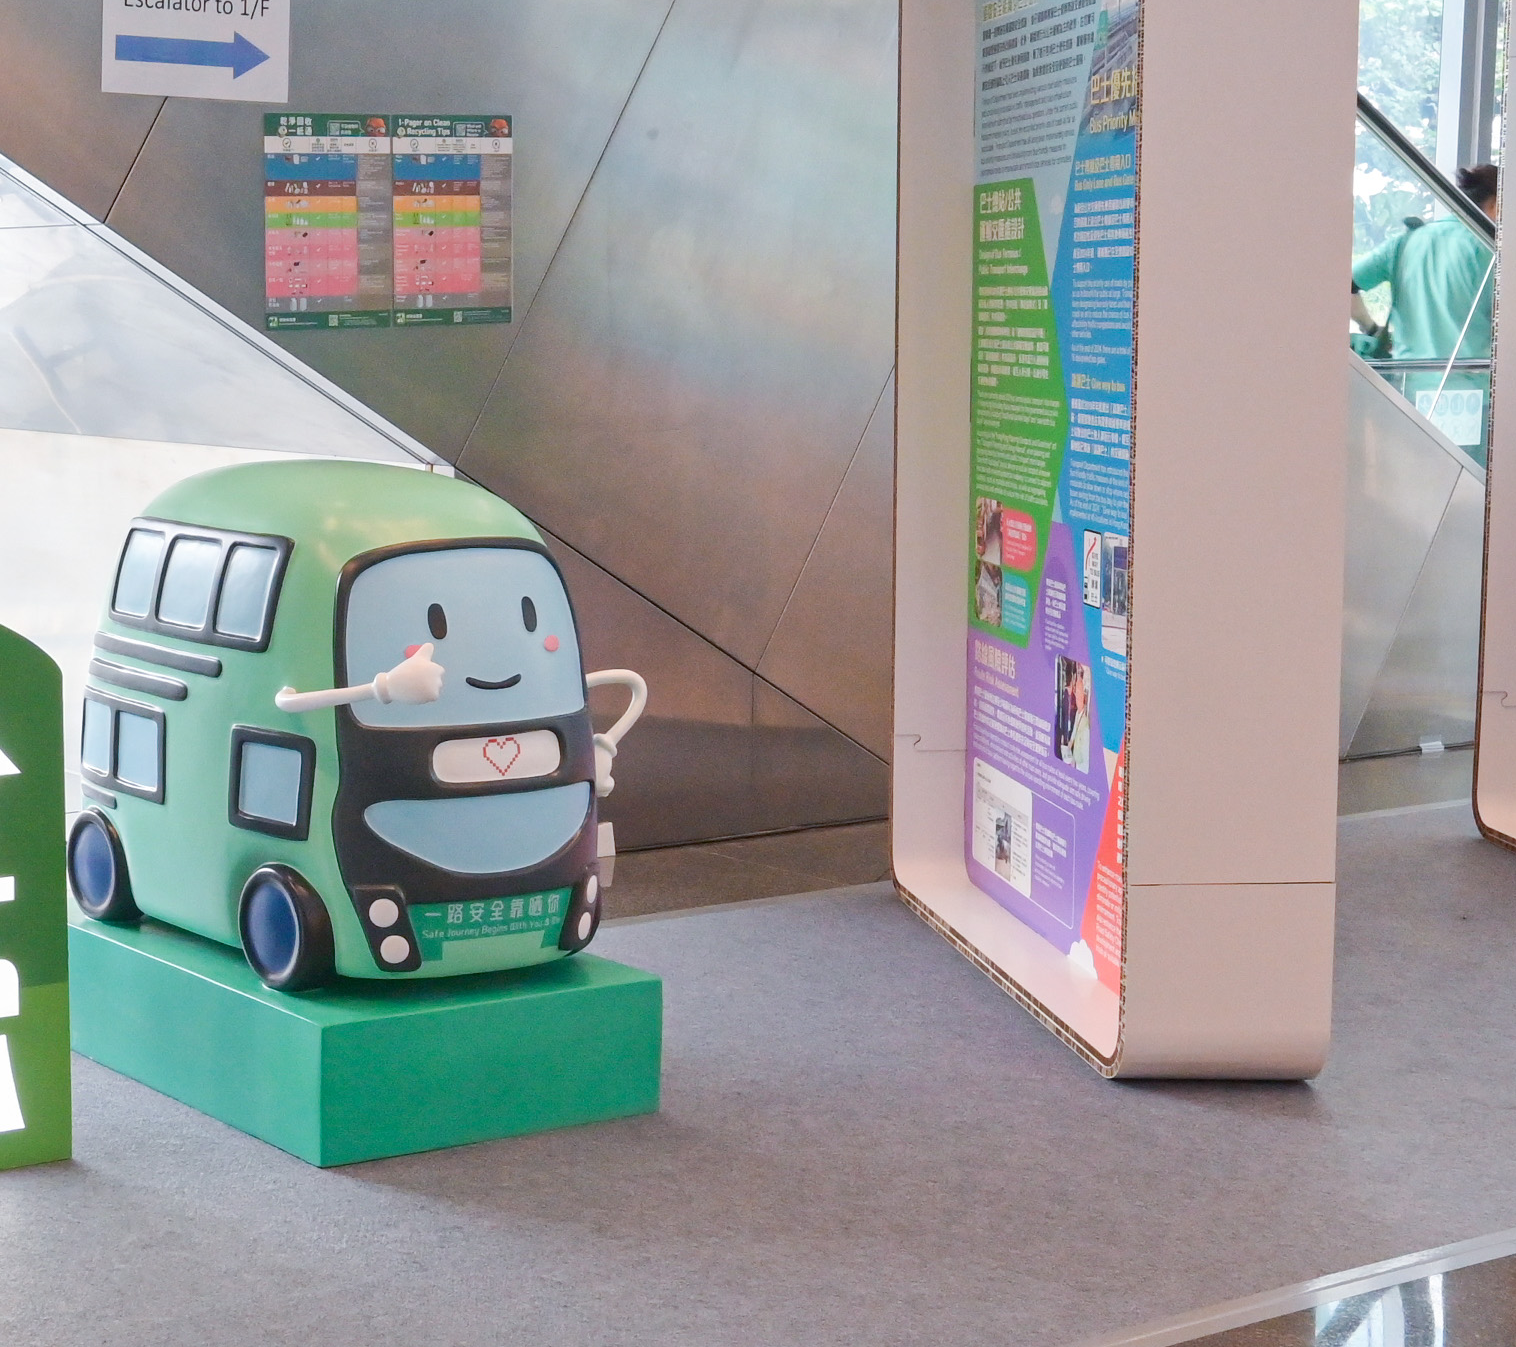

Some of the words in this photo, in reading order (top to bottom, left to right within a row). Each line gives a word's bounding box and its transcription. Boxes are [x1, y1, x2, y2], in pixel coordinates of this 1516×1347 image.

[1090, 118, 1103, 134] Bus
[1103, 112, 1128, 131] Priority
[425, 894, 560, 924] 一路安全靠晒你
[422, 930, 444, 939] Safe
[447, 927, 479, 938] Journey
[482, 924, 508, 935] Begins
